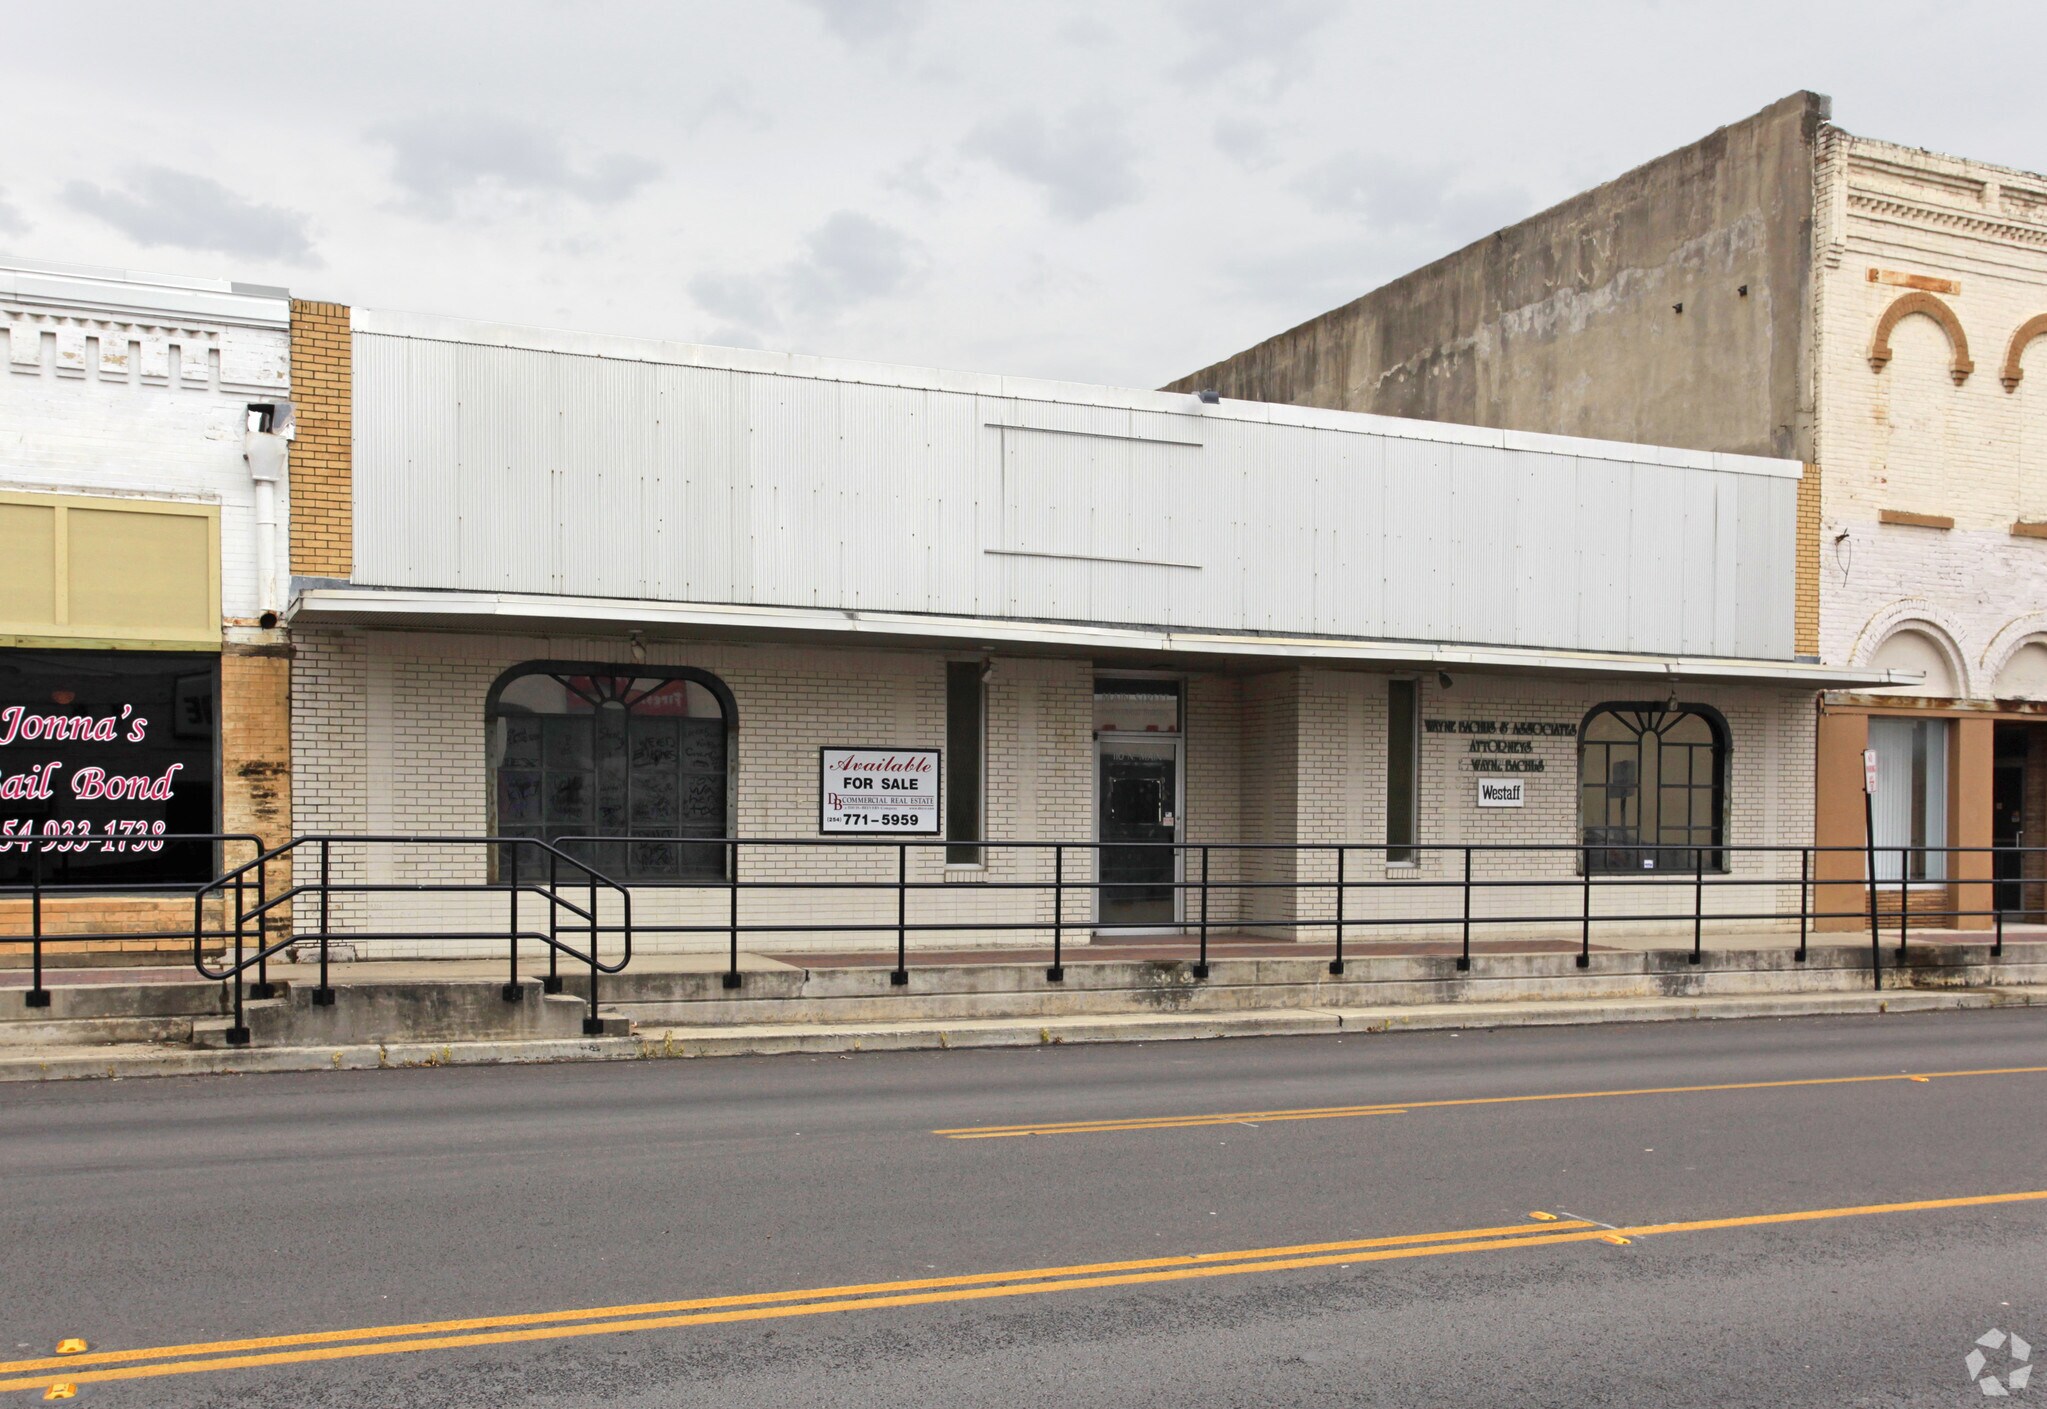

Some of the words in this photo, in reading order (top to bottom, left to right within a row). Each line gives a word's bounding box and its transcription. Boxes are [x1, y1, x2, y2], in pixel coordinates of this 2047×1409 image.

[0, 704, 148, 745] Jonna's
[1424, 719, 1456, 733] WAYNE
[1513, 722, 1577, 736] ASSOCIATES
[1469, 739, 1532, 754] ATTORNEYS
[829, 754, 933, 773] Available
[0, 762, 62, 800] ail
[71, 763, 183, 801] Bond
[843, 777, 873, 790] FOR
[881, 778, 919, 790] SALE
[842, 796, 888, 804] COMMERCIAL
[910, 797, 933, 805] ESTATE
[1482, 784, 1521, 801] Westaff
[843, 814, 919, 826] 771-5959
[41, 819, 166, 852] 933-1738
